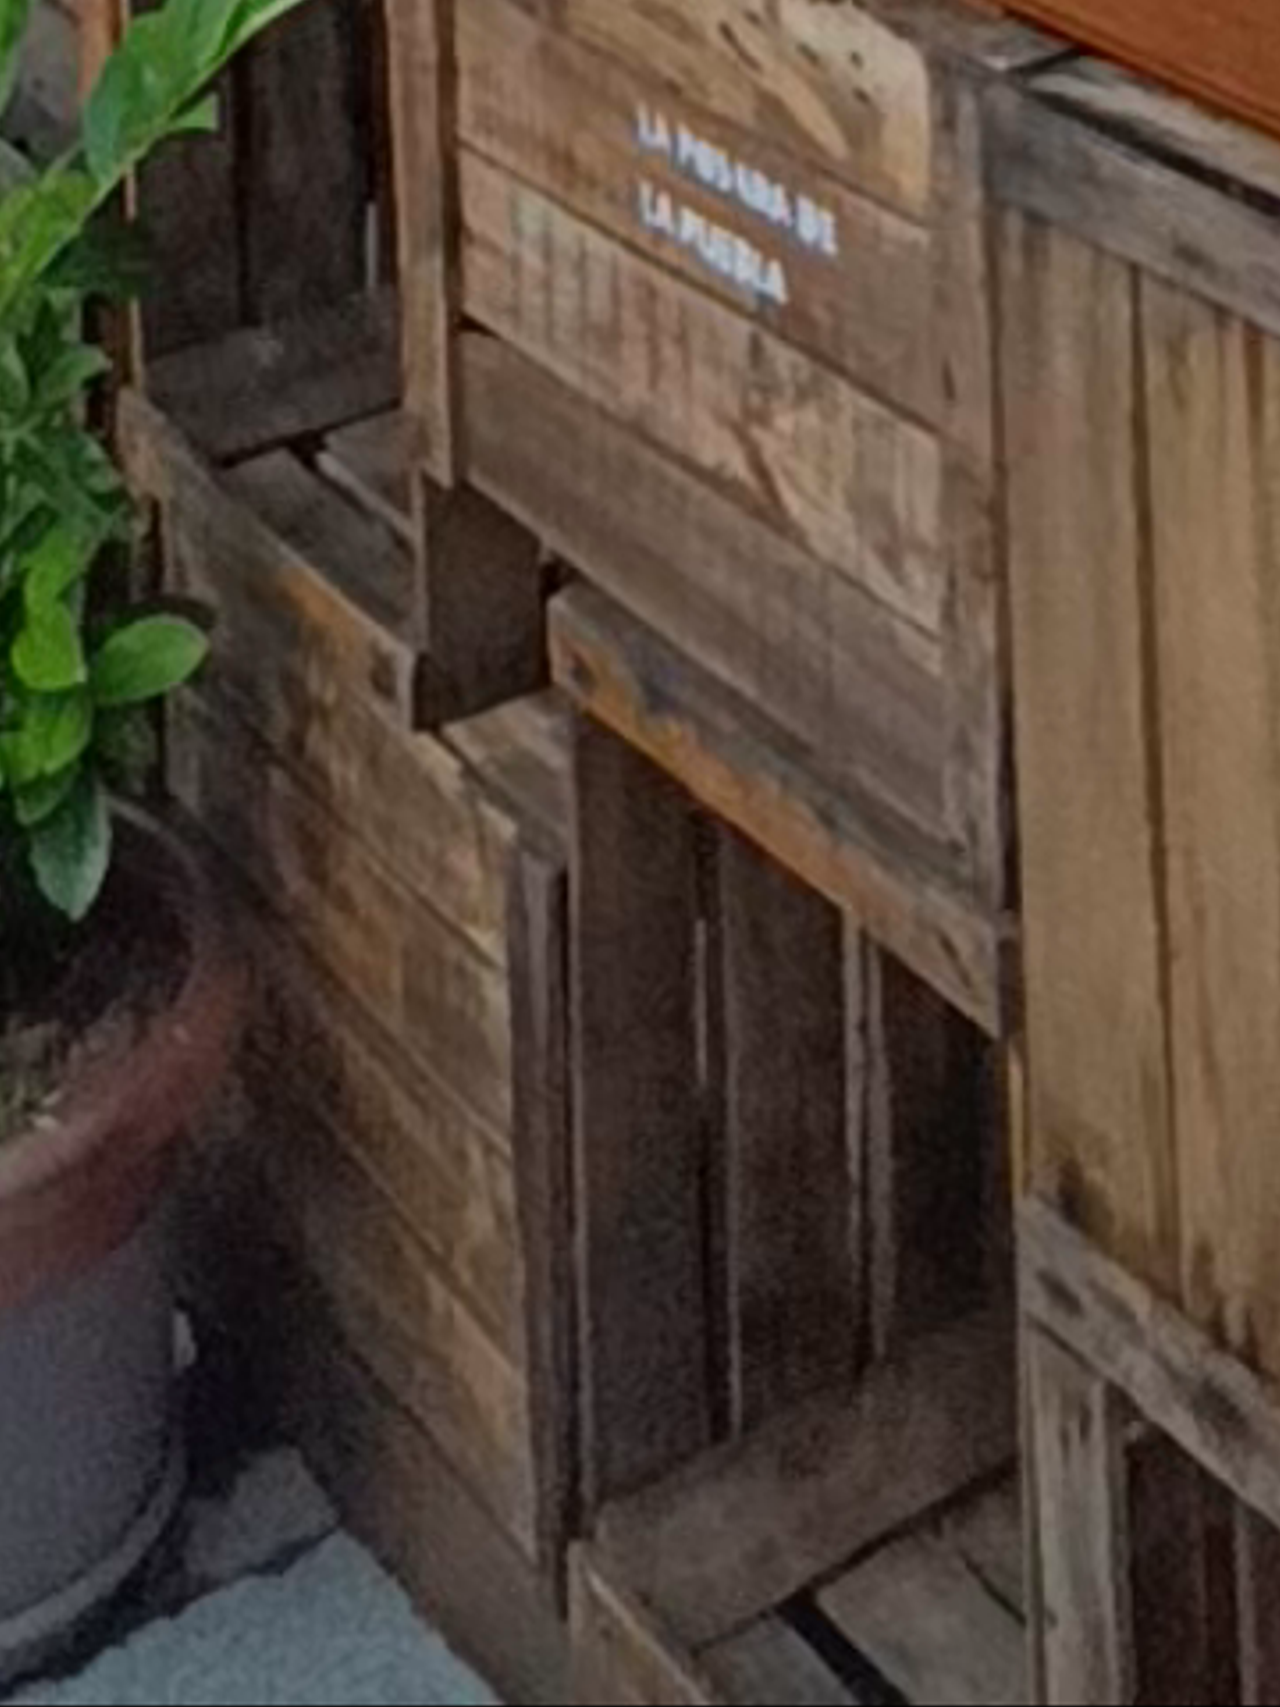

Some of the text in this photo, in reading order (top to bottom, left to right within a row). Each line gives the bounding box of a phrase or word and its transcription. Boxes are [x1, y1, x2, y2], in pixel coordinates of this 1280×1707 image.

[636, 102, 838, 257] LA POSADA DE
[638, 177, 789, 306] LA PUEBLA
